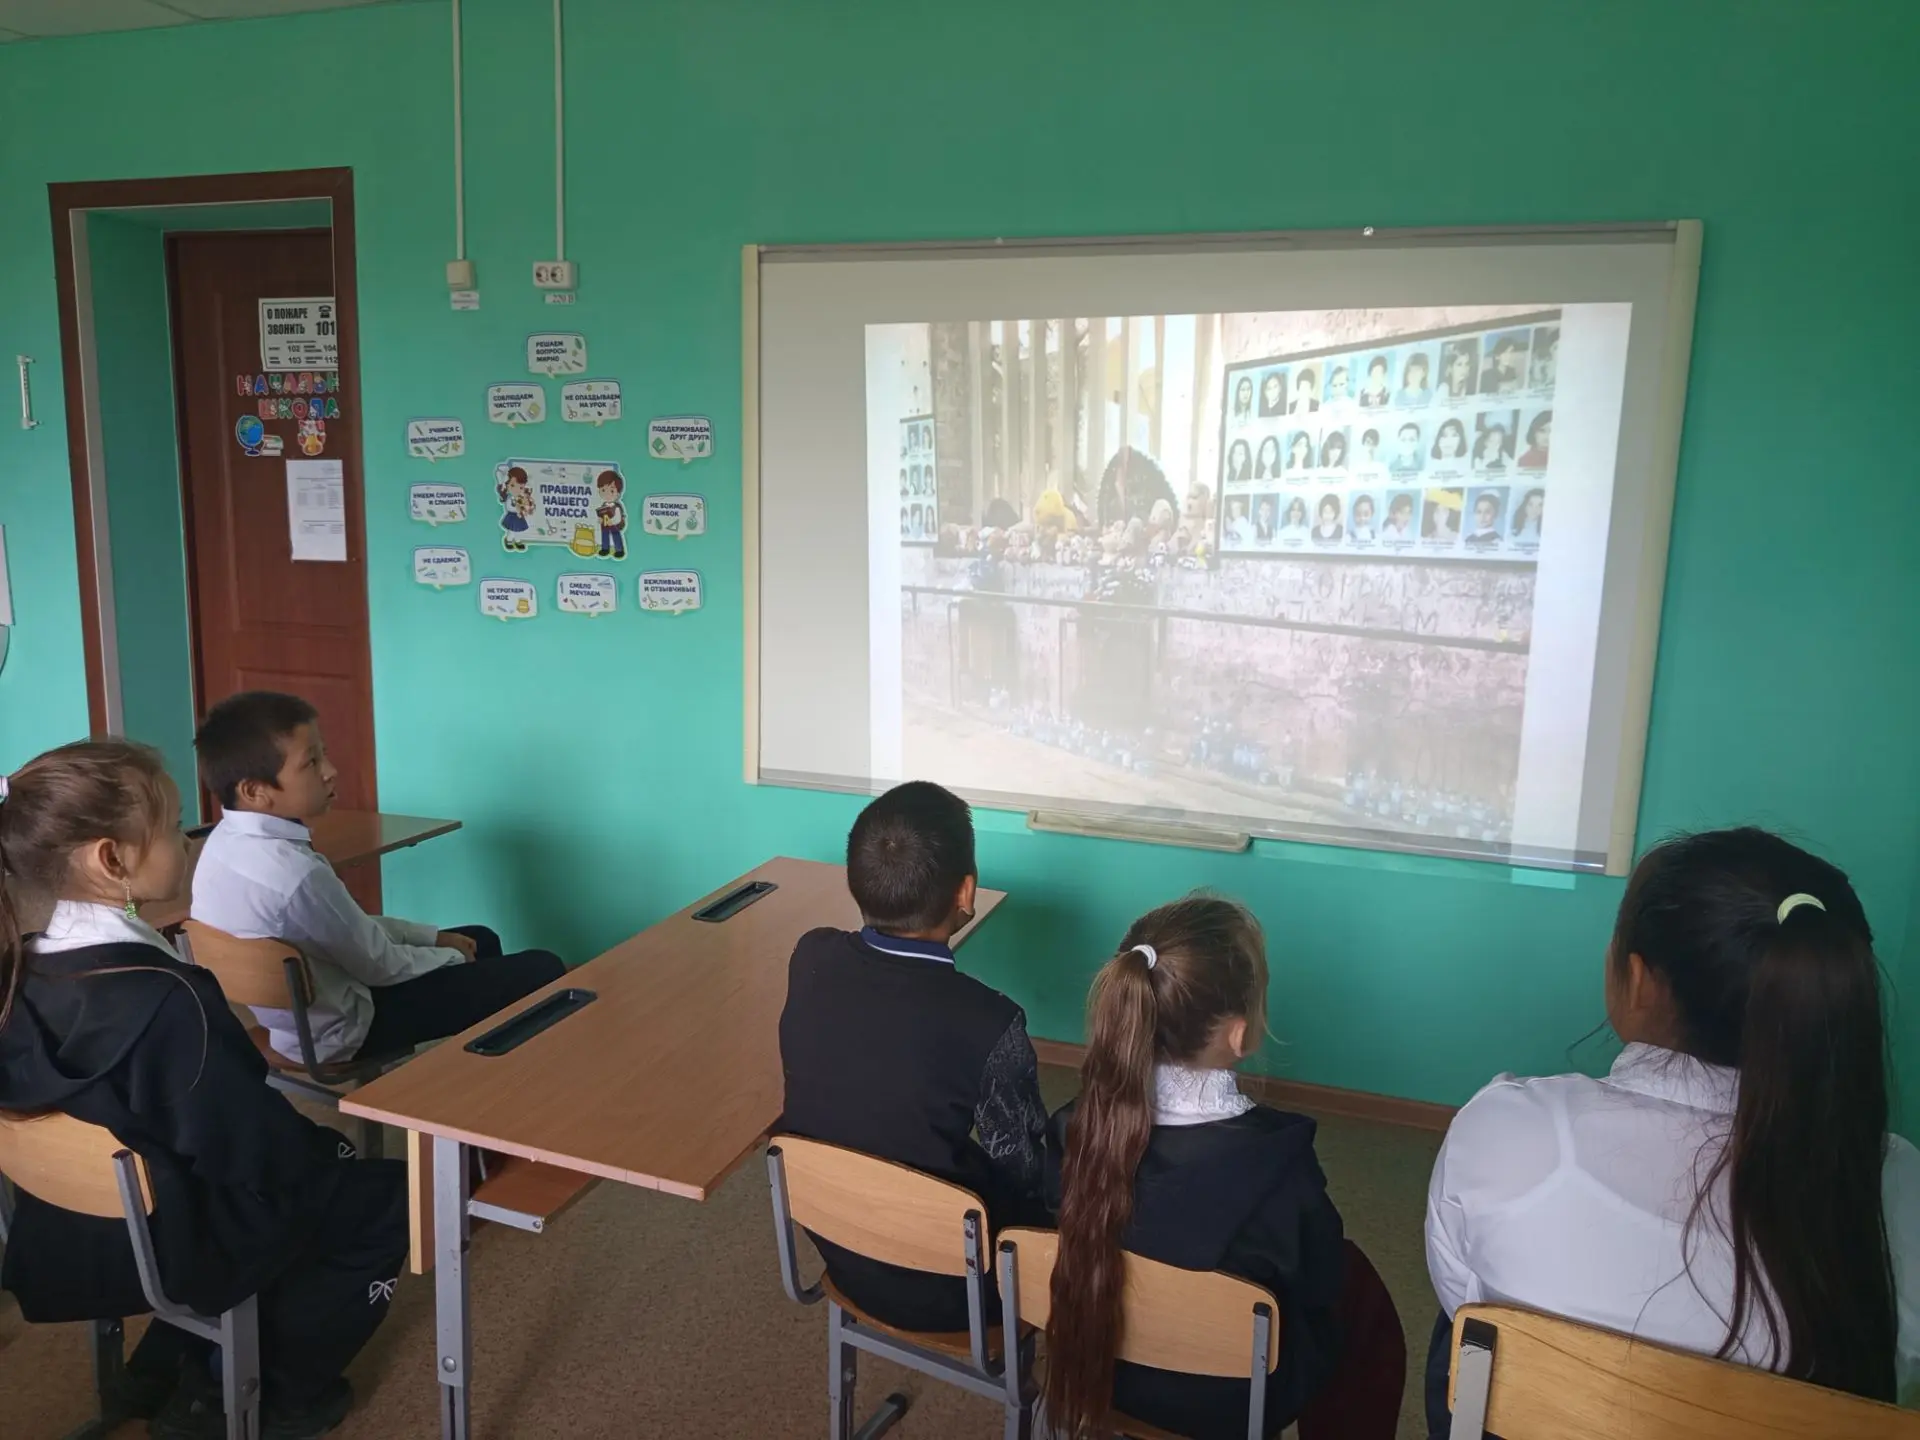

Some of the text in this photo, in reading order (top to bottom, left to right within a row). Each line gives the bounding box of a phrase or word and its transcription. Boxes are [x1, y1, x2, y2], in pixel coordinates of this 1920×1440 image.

[267, 307, 308, 319] О ПОЖАРЕ
[267, 320, 335, 336] ЗВОНИТЬ 101
[535, 340, 564, 348] РЕШАЕМ
[493, 393, 534, 402] СОБЛЮДАЕМ
[574, 393, 621, 401] ОПАЗДЫВАЕМ
[258, 397, 339, 419] ШКОЛА
[493, 401, 522, 409] ЧИСТОТУ
[589, 401, 607, 409] УРОК
[428, 426, 454, 434] УЧИМСЯ
[652, 425, 710, 433] ПОДДЕРЖИВАЕМ
[669, 433, 710, 441] ДРУГ ДРУГА
[539, 484, 593, 496] ПРАВИЛА
[435, 491, 465, 499] СЛУШАТЬ
[542, 495, 590, 508] НАШЕГО
[660, 502, 688, 510] БОИМСЯ
[544, 507, 589, 519] КЛАССА
[649, 509, 680, 517] ОШИБОК
[569, 582, 592, 590] СМЕЛО
[643, 578, 683, 586] ВЕЖЛИВЫЕ
[569, 589, 601, 597] МЕЧТАЕМ
[650, 585, 697, 593] ОТЗЫВЧИВЫЕ
[487, 594, 510, 602] ЧУЖОЕ
